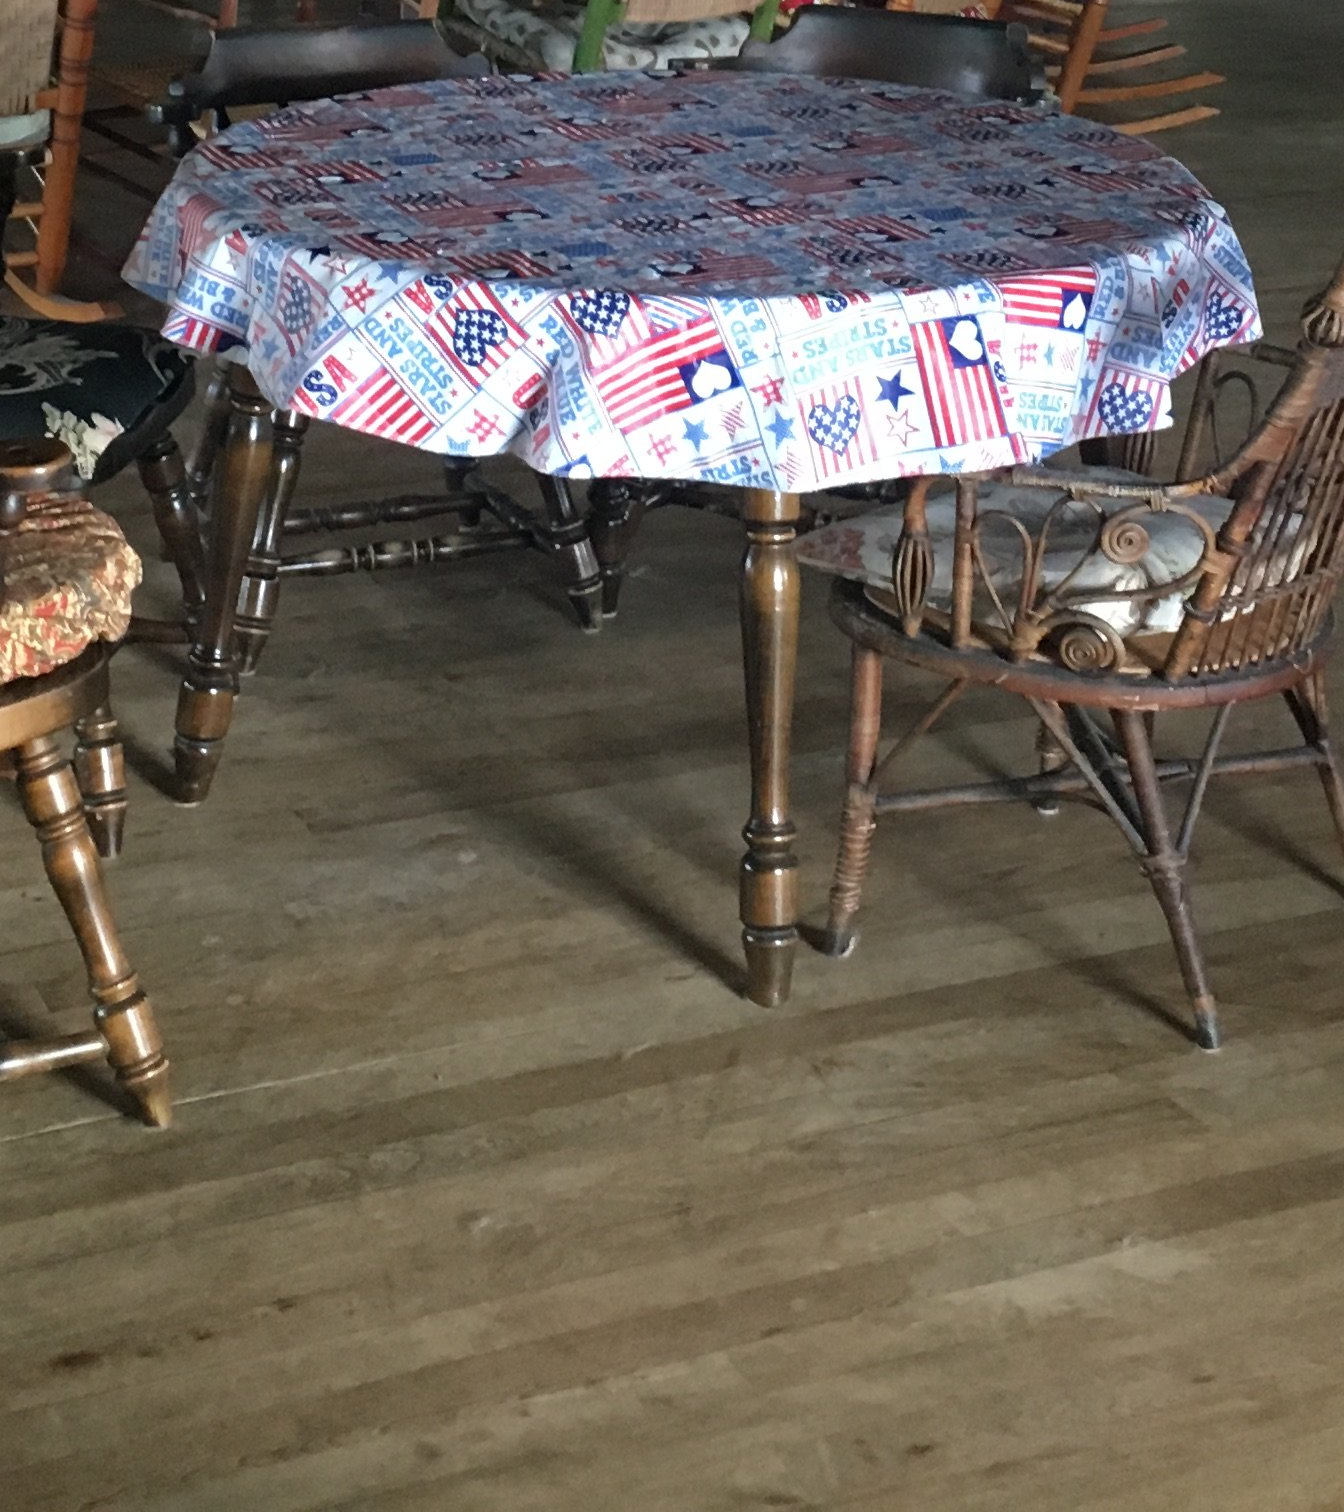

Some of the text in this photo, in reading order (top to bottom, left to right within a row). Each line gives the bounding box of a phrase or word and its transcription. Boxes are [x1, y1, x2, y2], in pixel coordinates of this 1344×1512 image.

[364, 317, 452, 416] STARS AND
[389, 318, 454, 390] STRIPES
[539, 314, 574, 360] RED
[731, 320, 759, 367] RED
